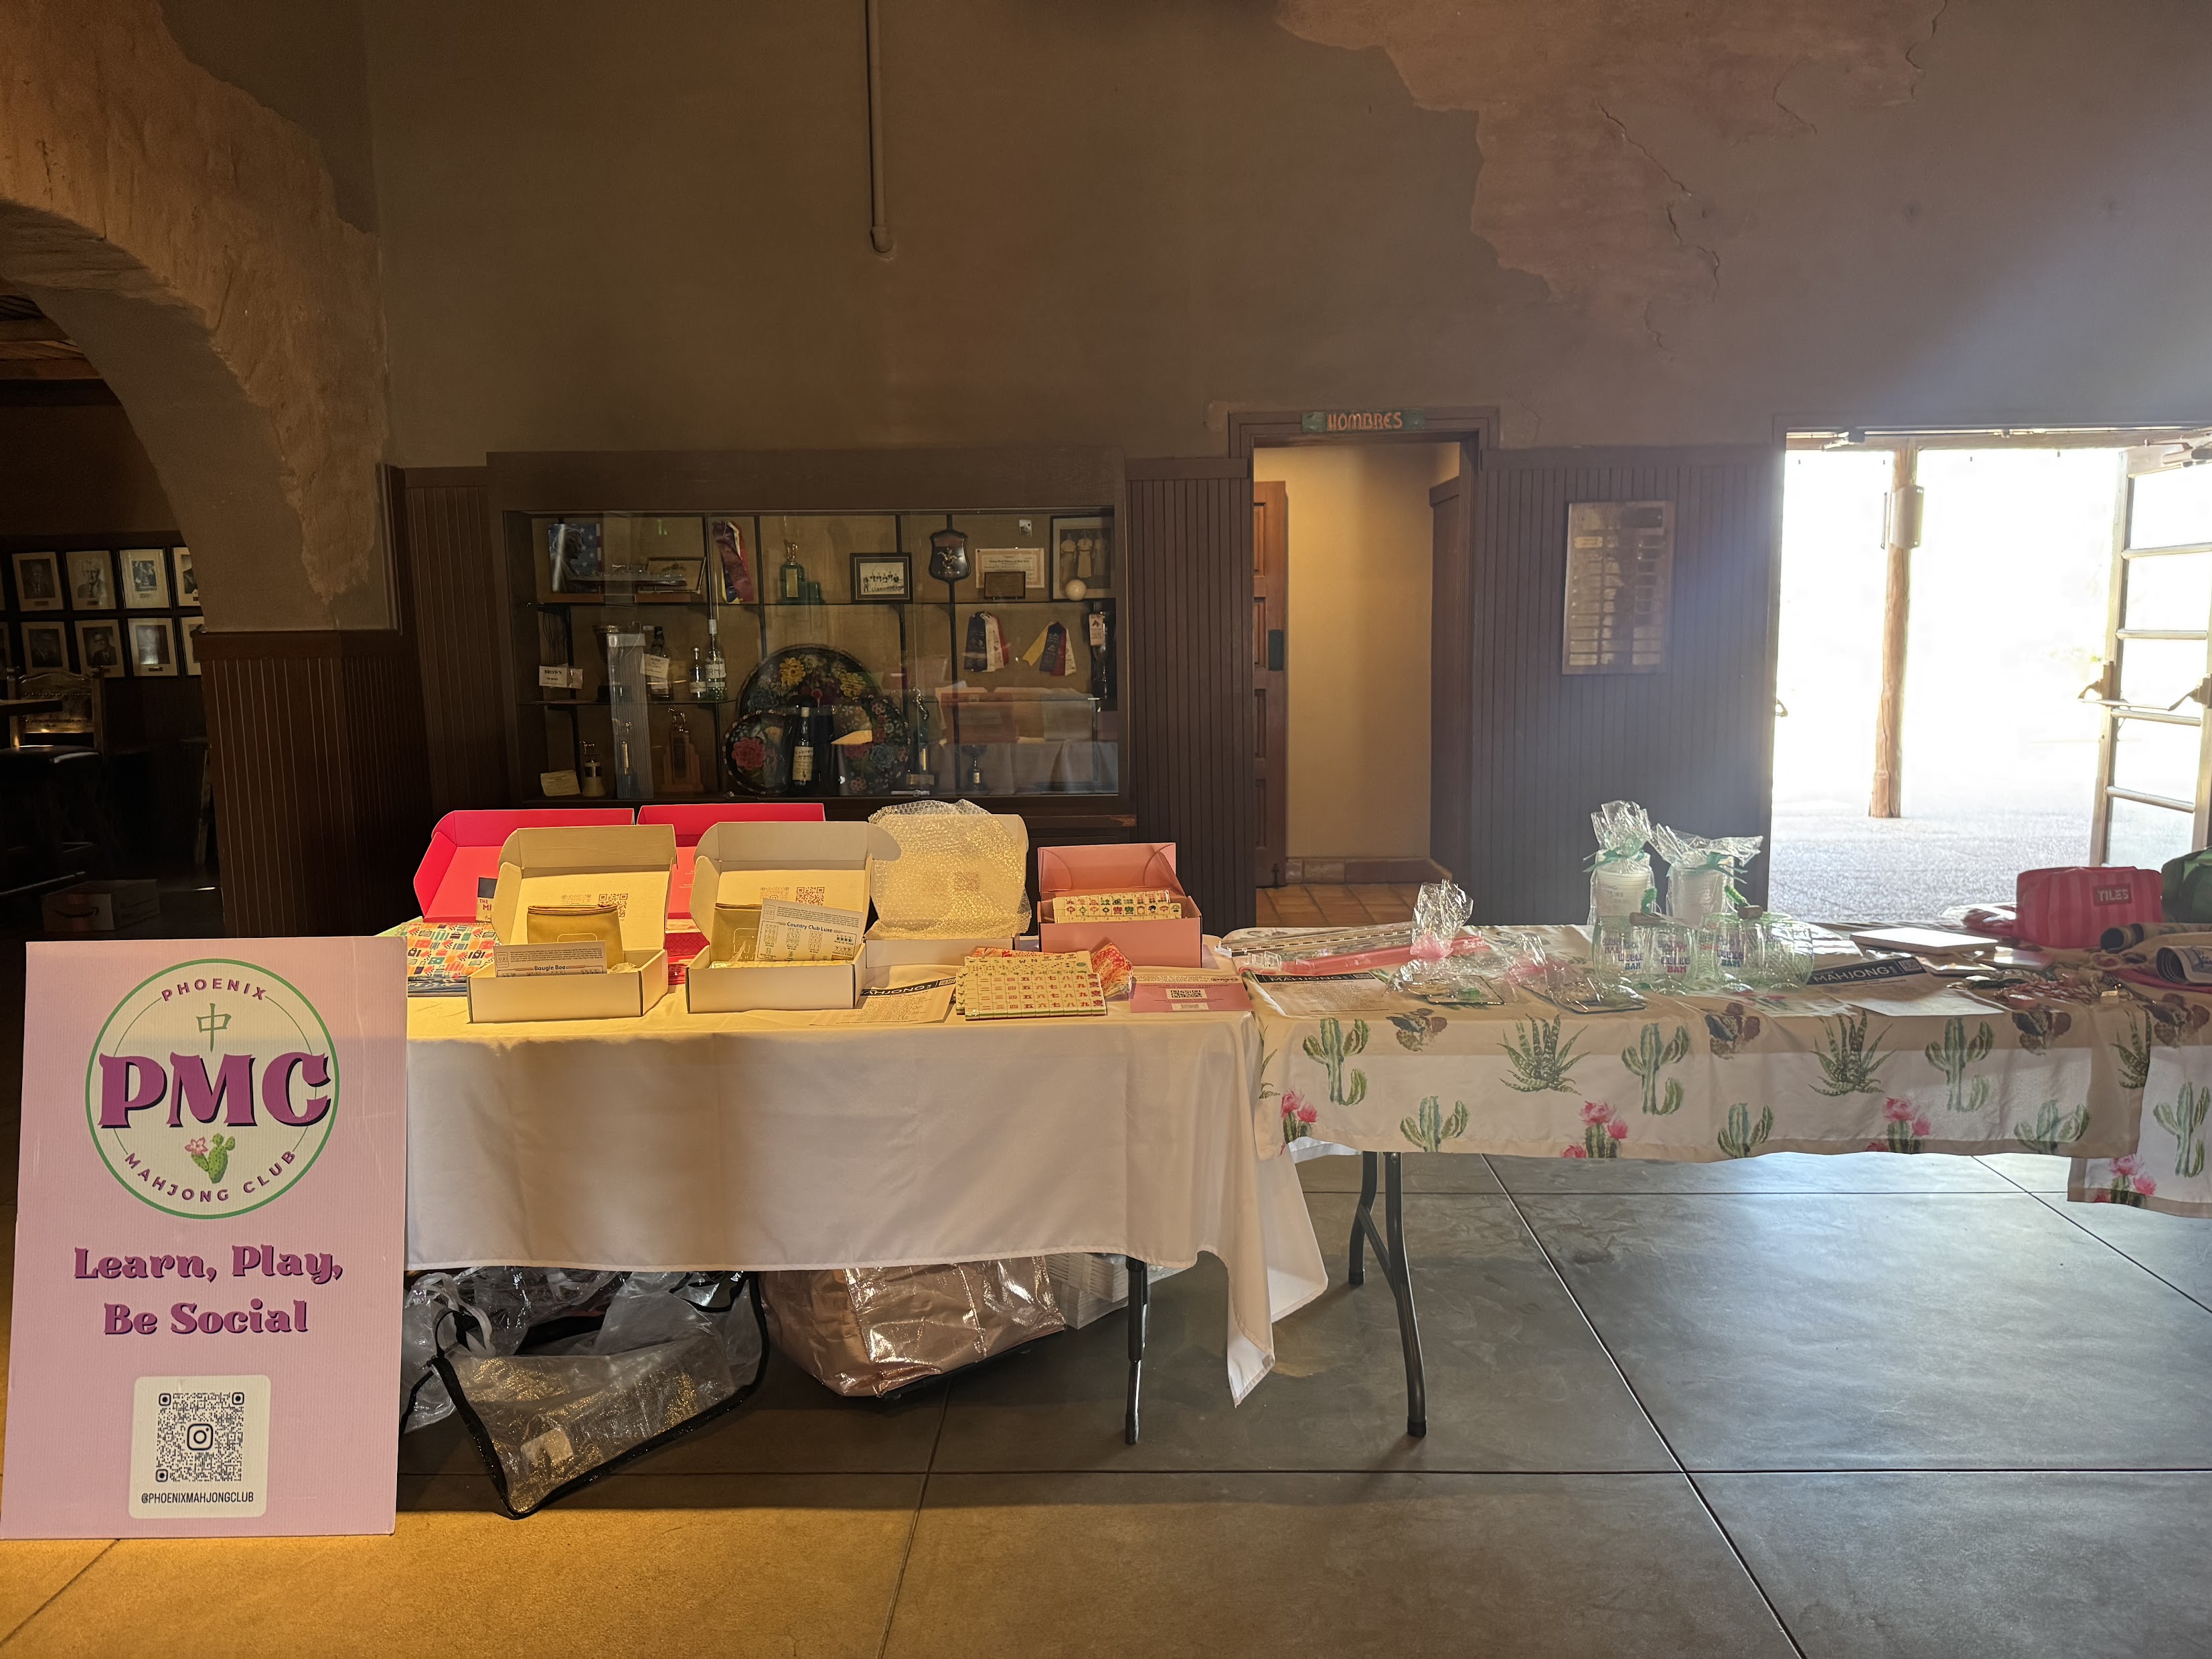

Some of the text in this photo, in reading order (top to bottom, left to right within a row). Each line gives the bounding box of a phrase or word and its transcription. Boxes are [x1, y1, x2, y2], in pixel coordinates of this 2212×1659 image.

[1327, 412, 1403, 430] HOMBRES
[2097, 888, 2129, 902] TILES
[787, 922, 807, 930] Country
[1813, 966, 1889, 982] MAHJONG
[161, 977, 267, 1002] PHOENIX
[195, 1003, 232, 1052] 中
[98, 1051, 331, 1129] PMC
[125, 1150, 297, 1202] MAHJONG CLUB
[74, 1244, 343, 1284] Learn, Play,
[104, 1298, 309, 1336] Be Social
[141, 1491, 254, 1504] @PHOENIXMAHJONGCLUB
